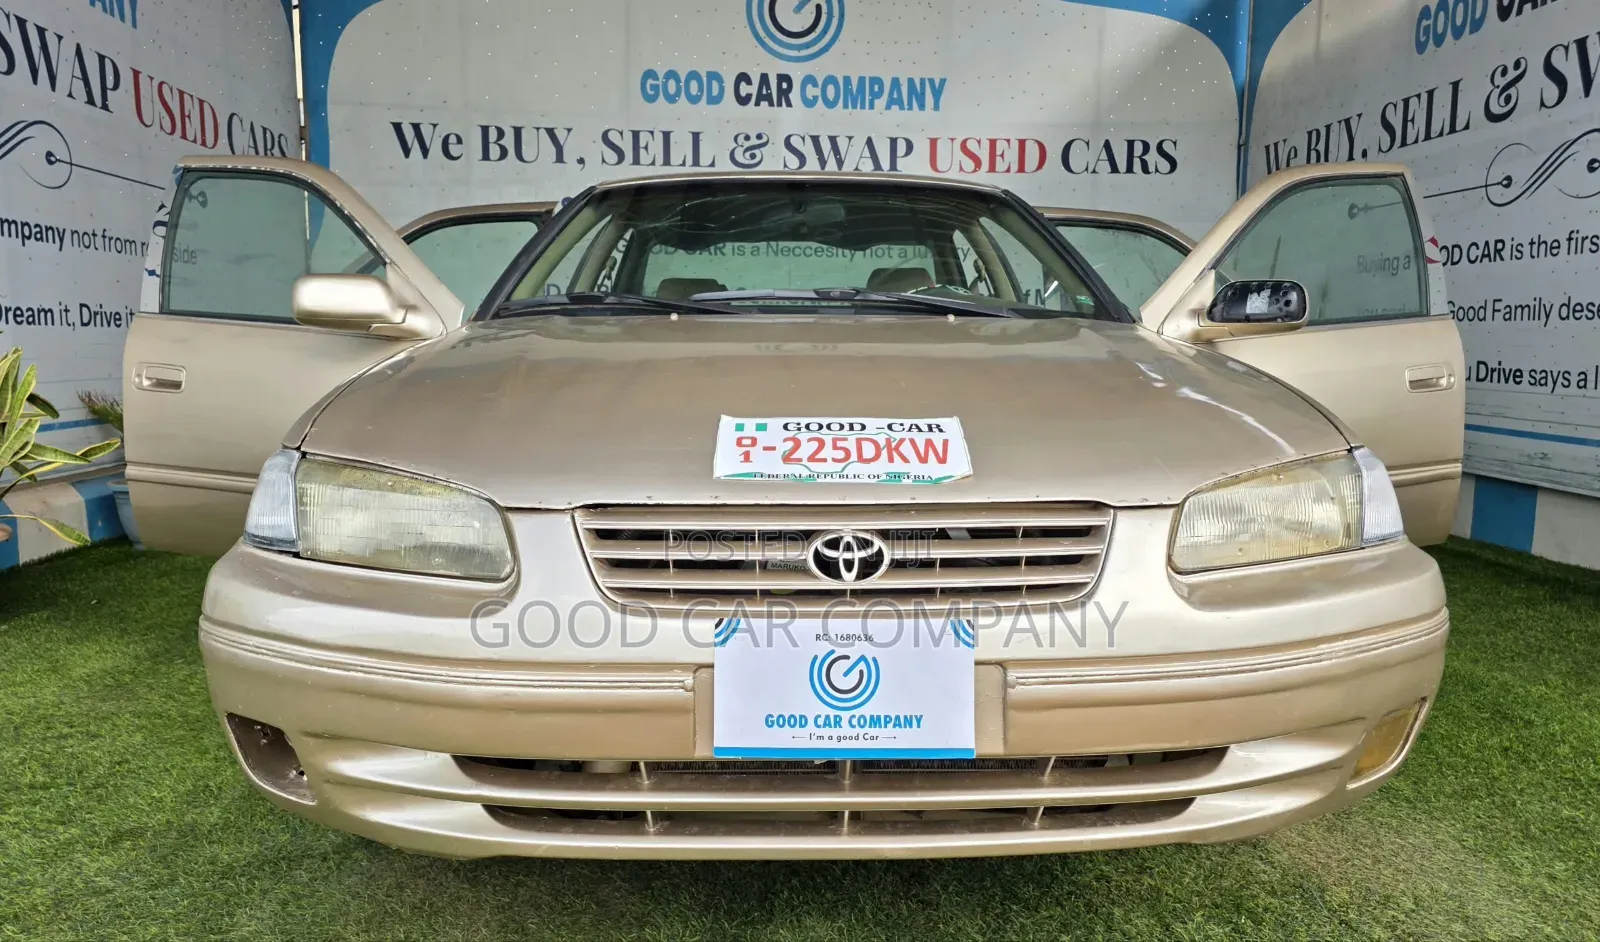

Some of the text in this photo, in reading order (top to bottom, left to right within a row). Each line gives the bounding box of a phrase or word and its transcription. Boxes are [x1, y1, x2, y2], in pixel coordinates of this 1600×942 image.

[1415, 0, 1489, 55] GOOD
[0, 6, 289, 158] SWAP USED CARS
[640, 68, 947, 112] GOOD CAR COMPANY
[1264, 138, 1298, 175] We
[1306, 113, 1368, 164] BUY,
[1378, 78, 1471, 153] SELL
[1484, 57, 1528, 123] &
[390, 121, 1178, 175] We BUY, SELL & SWAP USED CARS
[71, 229, 98, 251] not
[101, 228, 138, 257] from
[732, 242, 744, 256] is
[747, 246, 758, 257] a
[766, 241, 856, 261] Neccesity
[863, 246, 893, 259] not
[898, 247, 908, 258] a
[1403, 255, 1411, 271] a
[1466, 239, 1505, 265] CAR
[1510, 237, 1523, 260] is
[1529, 234, 1561, 258] the
[1566, 229, 1600, 256] firs
[0, 303, 55, 326] ream
[59, 301, 76, 331] it,
[79, 303, 122, 328] Drive
[1492, 297, 1553, 327] Family
[1476, 360, 1523, 385] Drive
[1528, 367, 1571, 393] says
[1577, 371, 1588, 389] a
[782, 422, 866, 432] GOOD
[815, 634, 874, 642] RC: 1680636
[764, 714, 924, 729] GOOD CAR COMPANY
[809, 733, 824, 741] I'm
[836, 733, 860, 743] good
[862, 733, 880, 741] Car
